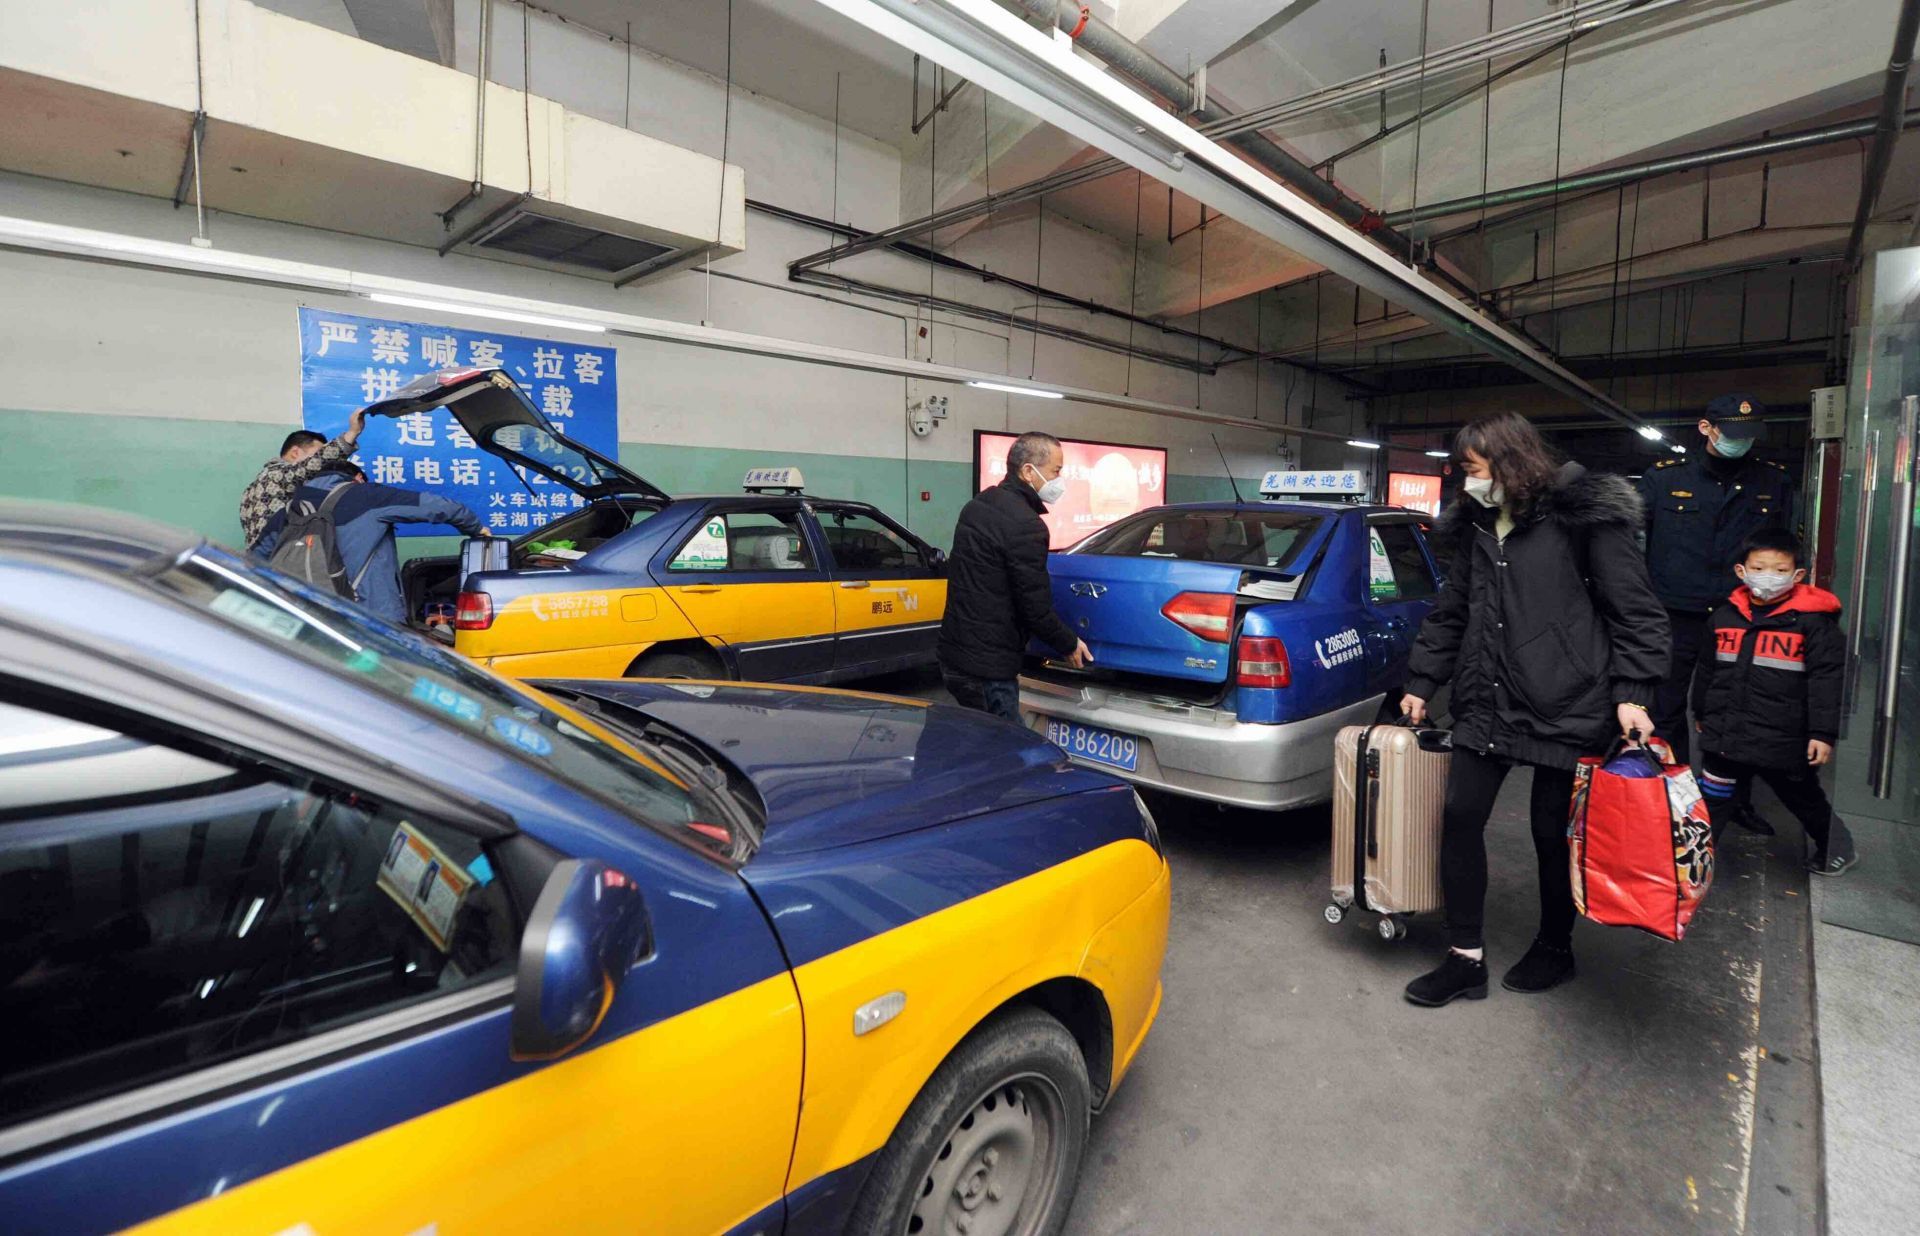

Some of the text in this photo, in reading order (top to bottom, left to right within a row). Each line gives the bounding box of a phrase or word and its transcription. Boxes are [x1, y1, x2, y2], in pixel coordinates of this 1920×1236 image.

[317, 320, 603, 384] 严禁喊客、拉客
[1265, 474, 1357, 489] 芜湖欢迎您
[489, 492, 593, 508] 火车站综管
[1325, 628, 1360, 654] 2863003
